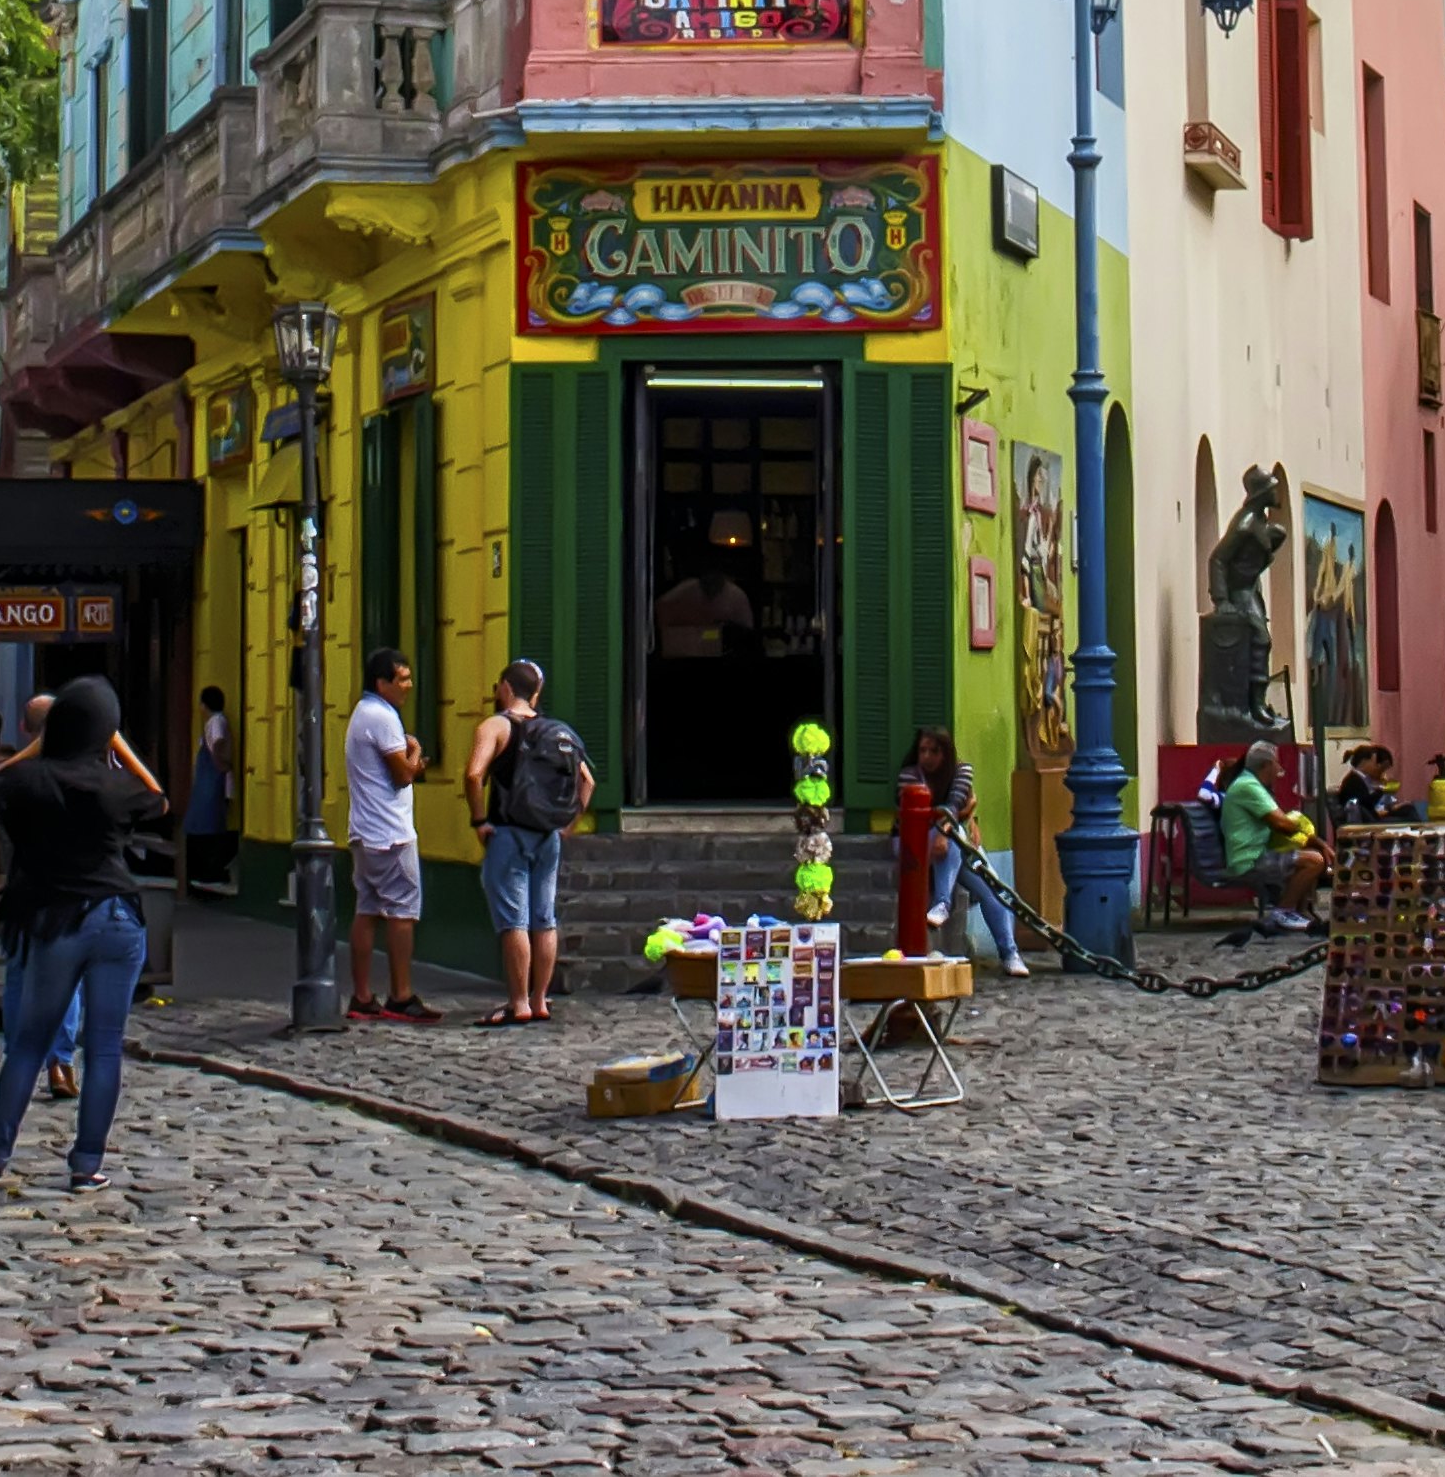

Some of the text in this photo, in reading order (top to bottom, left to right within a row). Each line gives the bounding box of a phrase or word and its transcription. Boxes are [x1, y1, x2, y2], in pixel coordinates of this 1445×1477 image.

[675, 10, 783, 29] AMIGO
[652, 183, 806, 213] HAVANNA
[584, 215, 876, 276] CAMINITO
